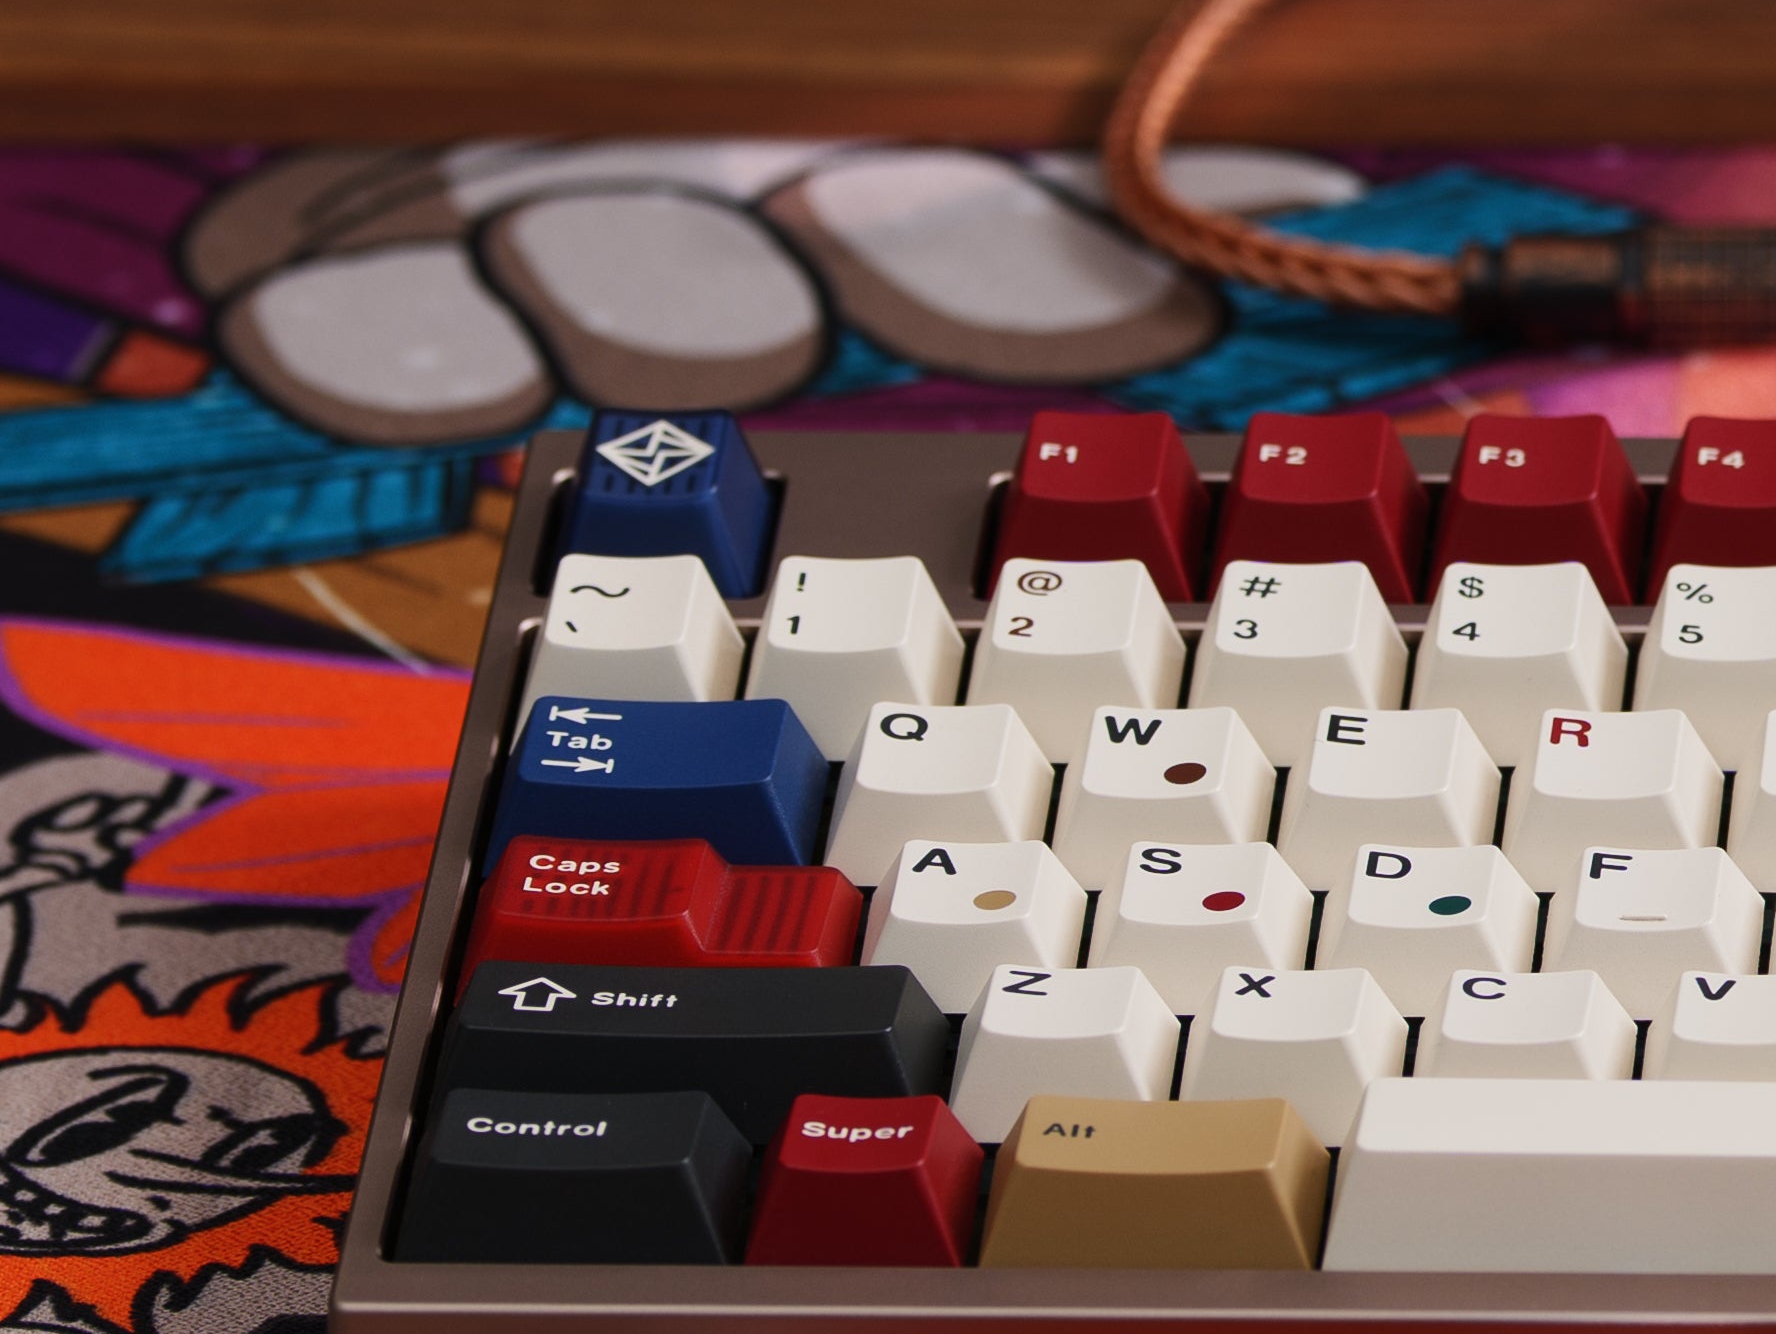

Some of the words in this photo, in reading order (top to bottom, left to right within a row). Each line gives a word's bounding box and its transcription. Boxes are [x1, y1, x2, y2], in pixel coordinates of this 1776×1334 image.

[1040, 443, 1077, 463] F1
[1260, 445, 1306, 464] F2
[1479, 446, 1525, 467] F3
[1698, 447, 1744, 468] F4
[571, 585, 630, 597] ~
[798, 573, 806, 591] !
[1018, 571, 1062, 595] @
[1241, 577, 1280, 598] #
[1459, 577, 1483, 598] $
[1677, 583, 1713, 603] %
[788, 616, 800, 634] 1
[1009, 617, 1033, 637] 2
[1234, 620, 1257, 639] 3
[1453, 622, 1479, 640] 4
[1679, 625, 1703, 643] 5
[880, 714, 928, 741] Q
[1105, 716, 1162, 745] W
[1327, 715, 1368, 745] E
[1550, 717, 1591, 747] R
[547, 731, 612, 750] Tab
[530, 855, 619, 875] Caps
[912, 849, 956, 875] A
[1140, 849, 1181, 874] S
[1366, 851, 1411, 879] D
[1590, 853, 1632, 879] F
[523, 877, 609, 895] Lock
[1002, 971, 1051, 995] Z
[1235, 974, 1275, 997] X
[1463, 978, 1506, 999] C
[1696, 977, 1736, 1000] V
[591, 992, 677, 1007] Shift
[467, 1117, 607, 1136] Control
[802, 1122, 913, 1142] Super
[1043, 1123, 1094, 1138] Alt
